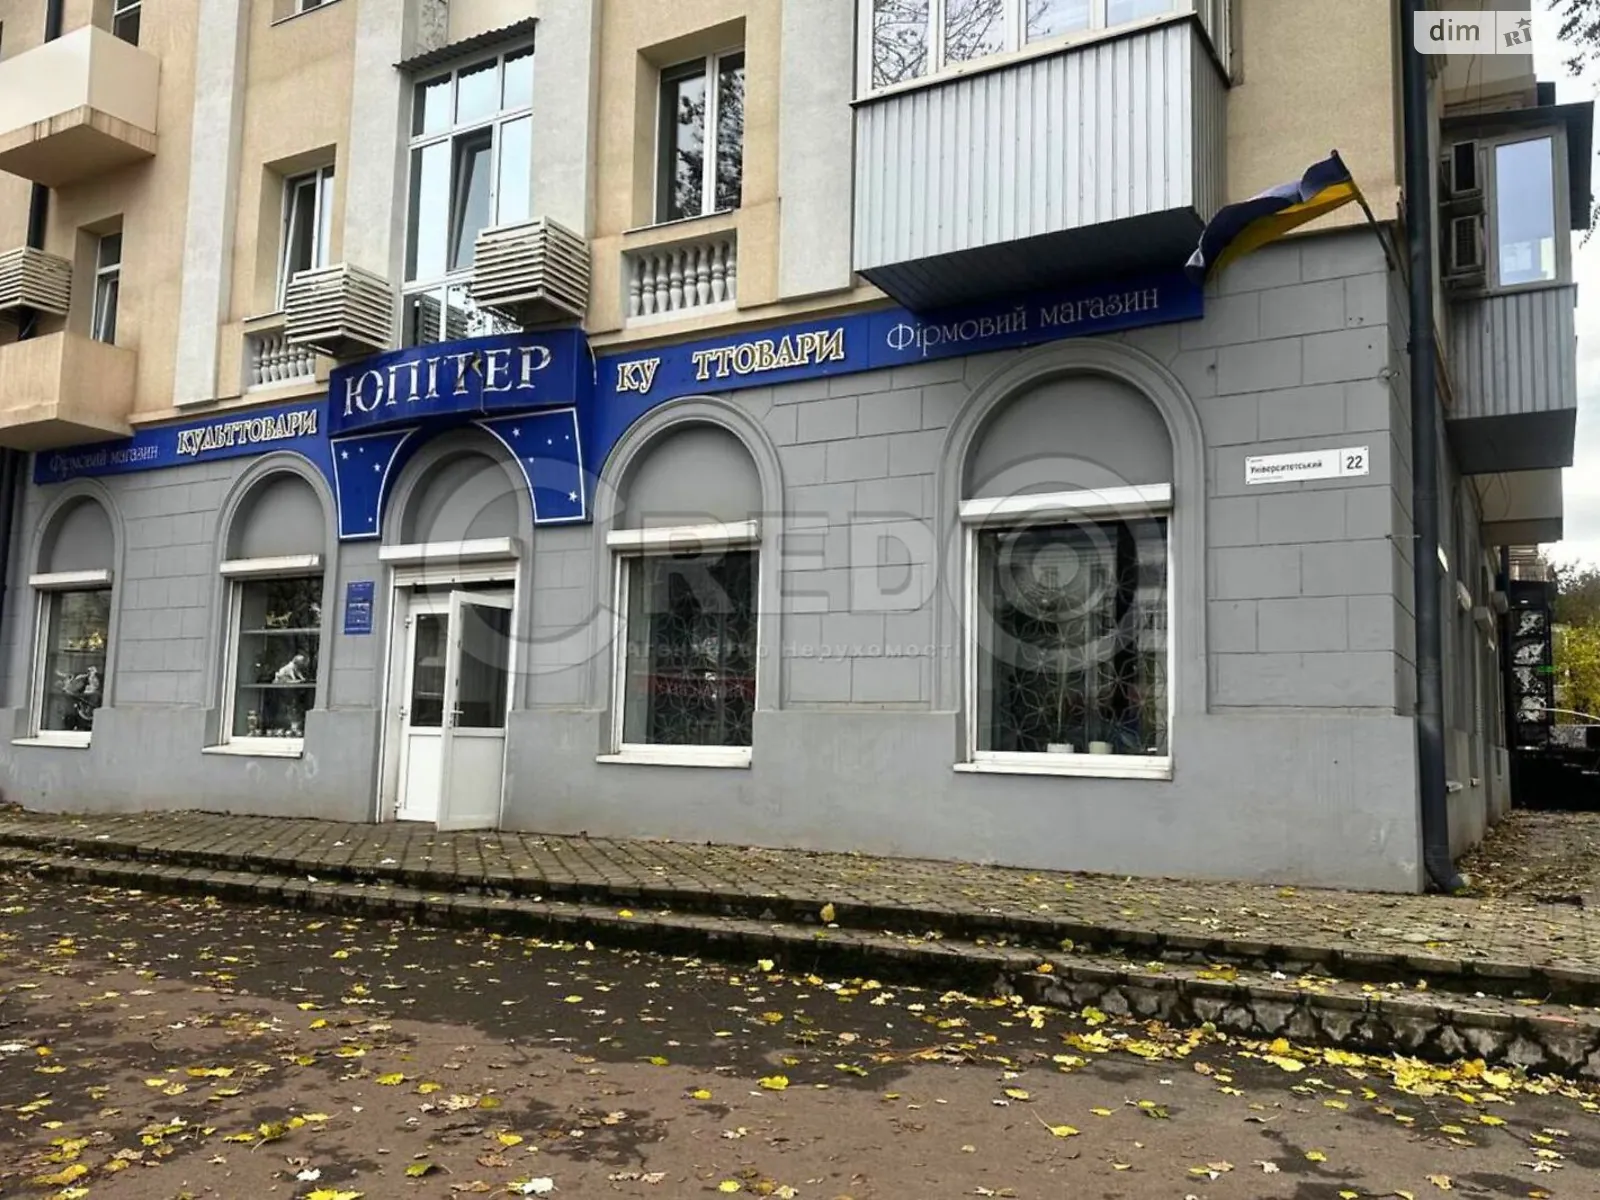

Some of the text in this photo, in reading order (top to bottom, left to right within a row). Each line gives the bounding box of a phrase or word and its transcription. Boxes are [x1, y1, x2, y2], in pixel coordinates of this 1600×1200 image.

[887, 288, 1159, 356] Фірмовий магазин
[343, 345, 552, 417] ЮПІТЕР
[616, 328, 844, 394] КУ ТТОВАРИ
[176, 408, 318, 456] КУЛЬТТОВАРИ
[1345, 455, 1363, 470] 22
